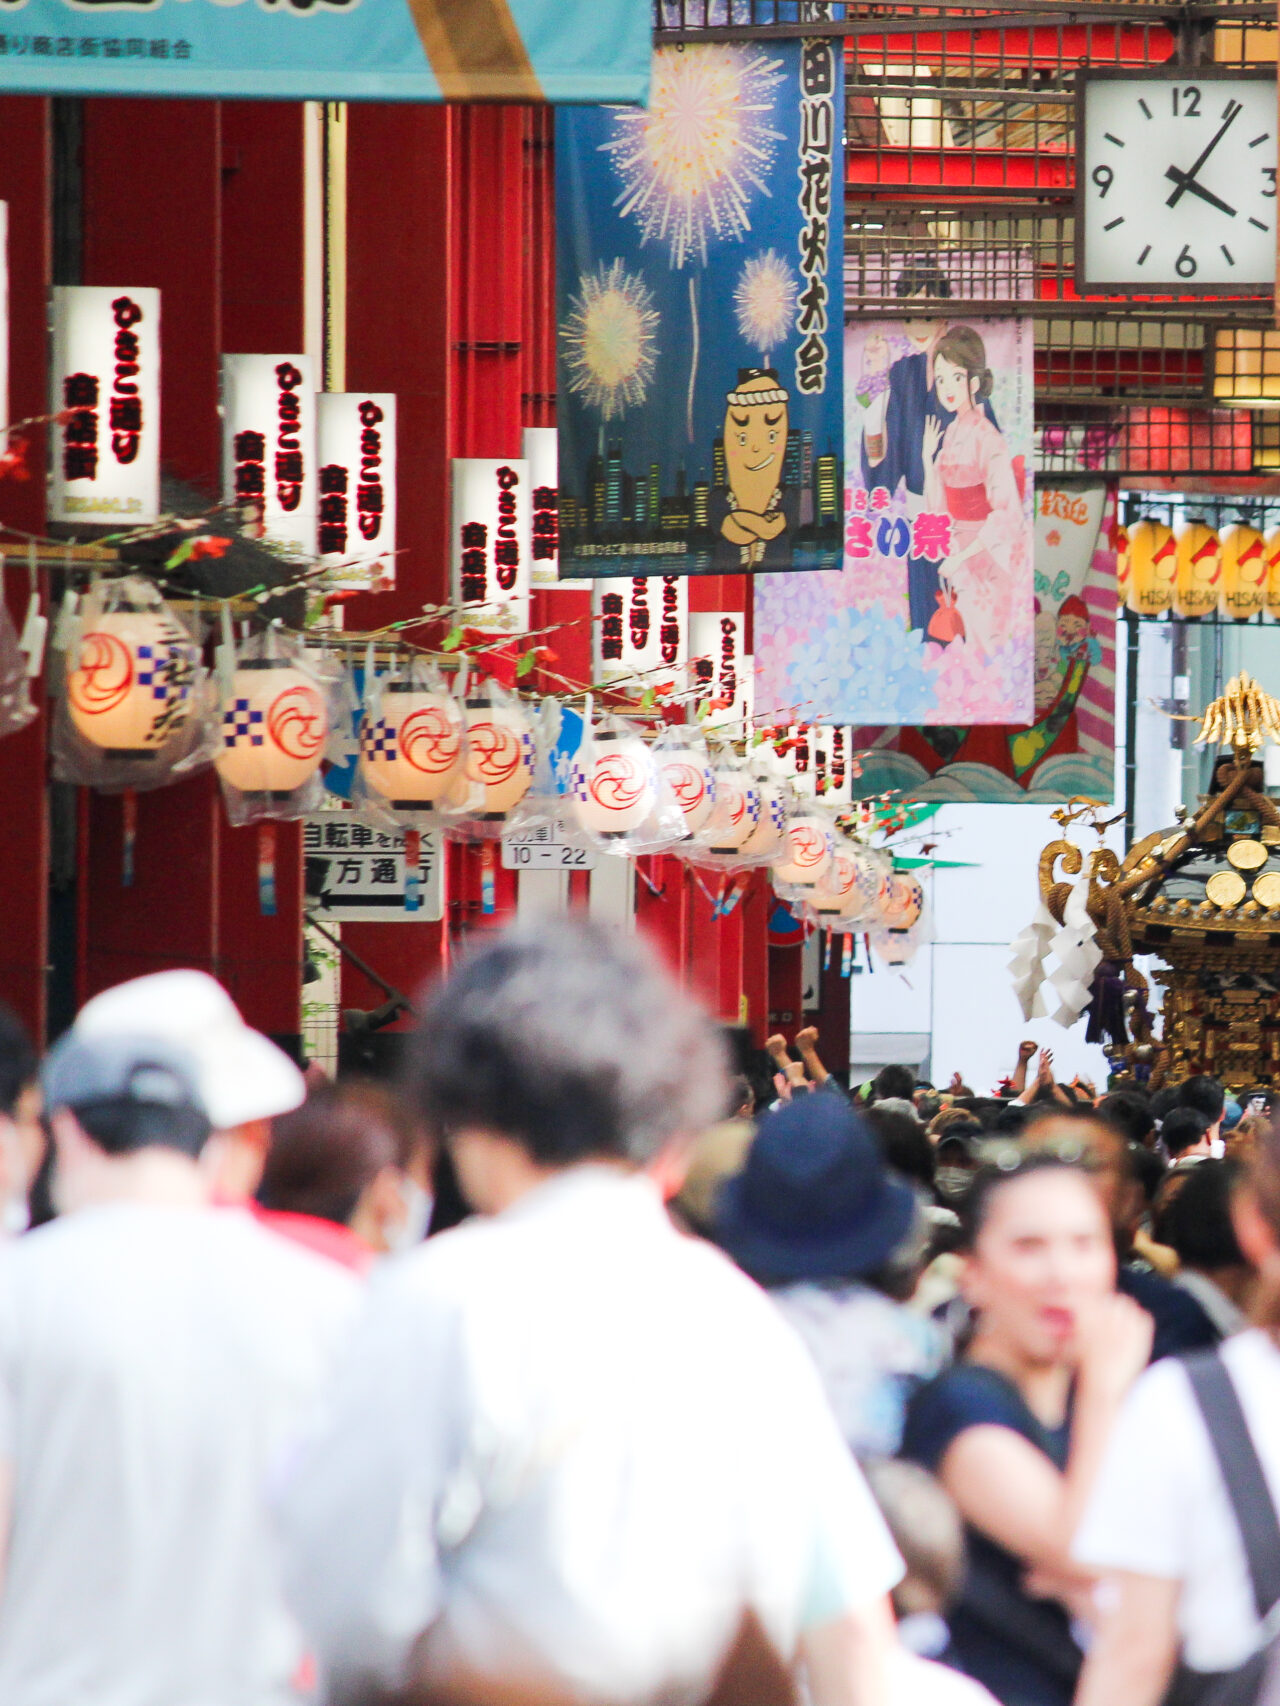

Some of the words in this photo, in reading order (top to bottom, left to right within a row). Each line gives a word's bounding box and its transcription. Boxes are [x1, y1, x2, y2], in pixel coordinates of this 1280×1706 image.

[1172, 86, 1201, 116] 12
[1092, 165, 1114, 198] 9
[1261, 168, 1277, 197] 3
[1175, 244, 1197, 278] 6
[513, 846, 531, 864] 10
[561, 846, 587, 864] 22
